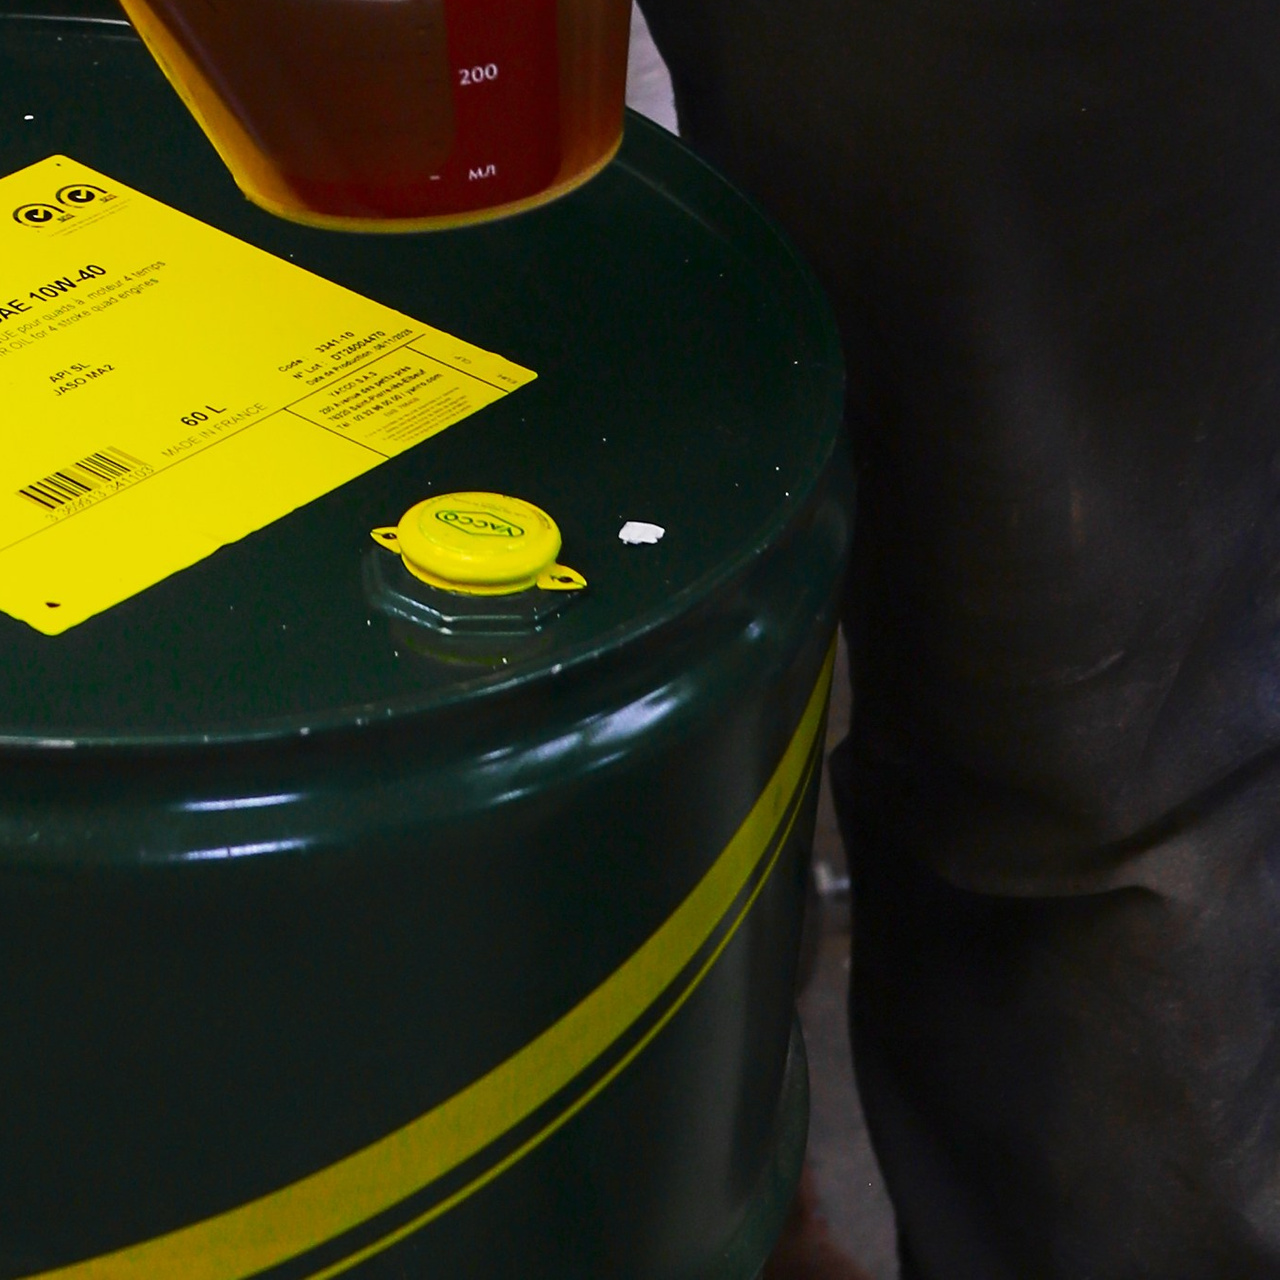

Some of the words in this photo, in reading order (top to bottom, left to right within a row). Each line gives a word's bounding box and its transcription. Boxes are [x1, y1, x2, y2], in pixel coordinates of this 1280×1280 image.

[458, 62, 499, 86] 200
[468, 163, 497, 182] мл
[16, 318, 41, 334] pour
[41, 303, 76, 321] quads
[86, 279, 124, 299] moteur
[130, 260, 166, 278] temps
[29, 264, 106, 301] 10W-40
[8, 337, 34, 350] OIL
[29, 329, 48, 339] for
[57, 310, 91, 327] stroke
[90, 296, 119, 312] quad
[117, 277, 159, 299] engines
[277, 358, 303, 372] Code
[314, 331, 355, 353] 3341-10
[49, 369, 72, 383] API
[69, 362, 90, 372] SL
[54, 377, 87, 396] JASO
[85, 364, 114, 379] MA2
[161, 435, 202, 456] MADE
[198, 428, 216, 438] IN
[212, 402, 267, 431] FRANCE
[180, 411, 209, 426] 60
[204, 404, 227, 414] L
[443, 511, 516, 537] YACCO
